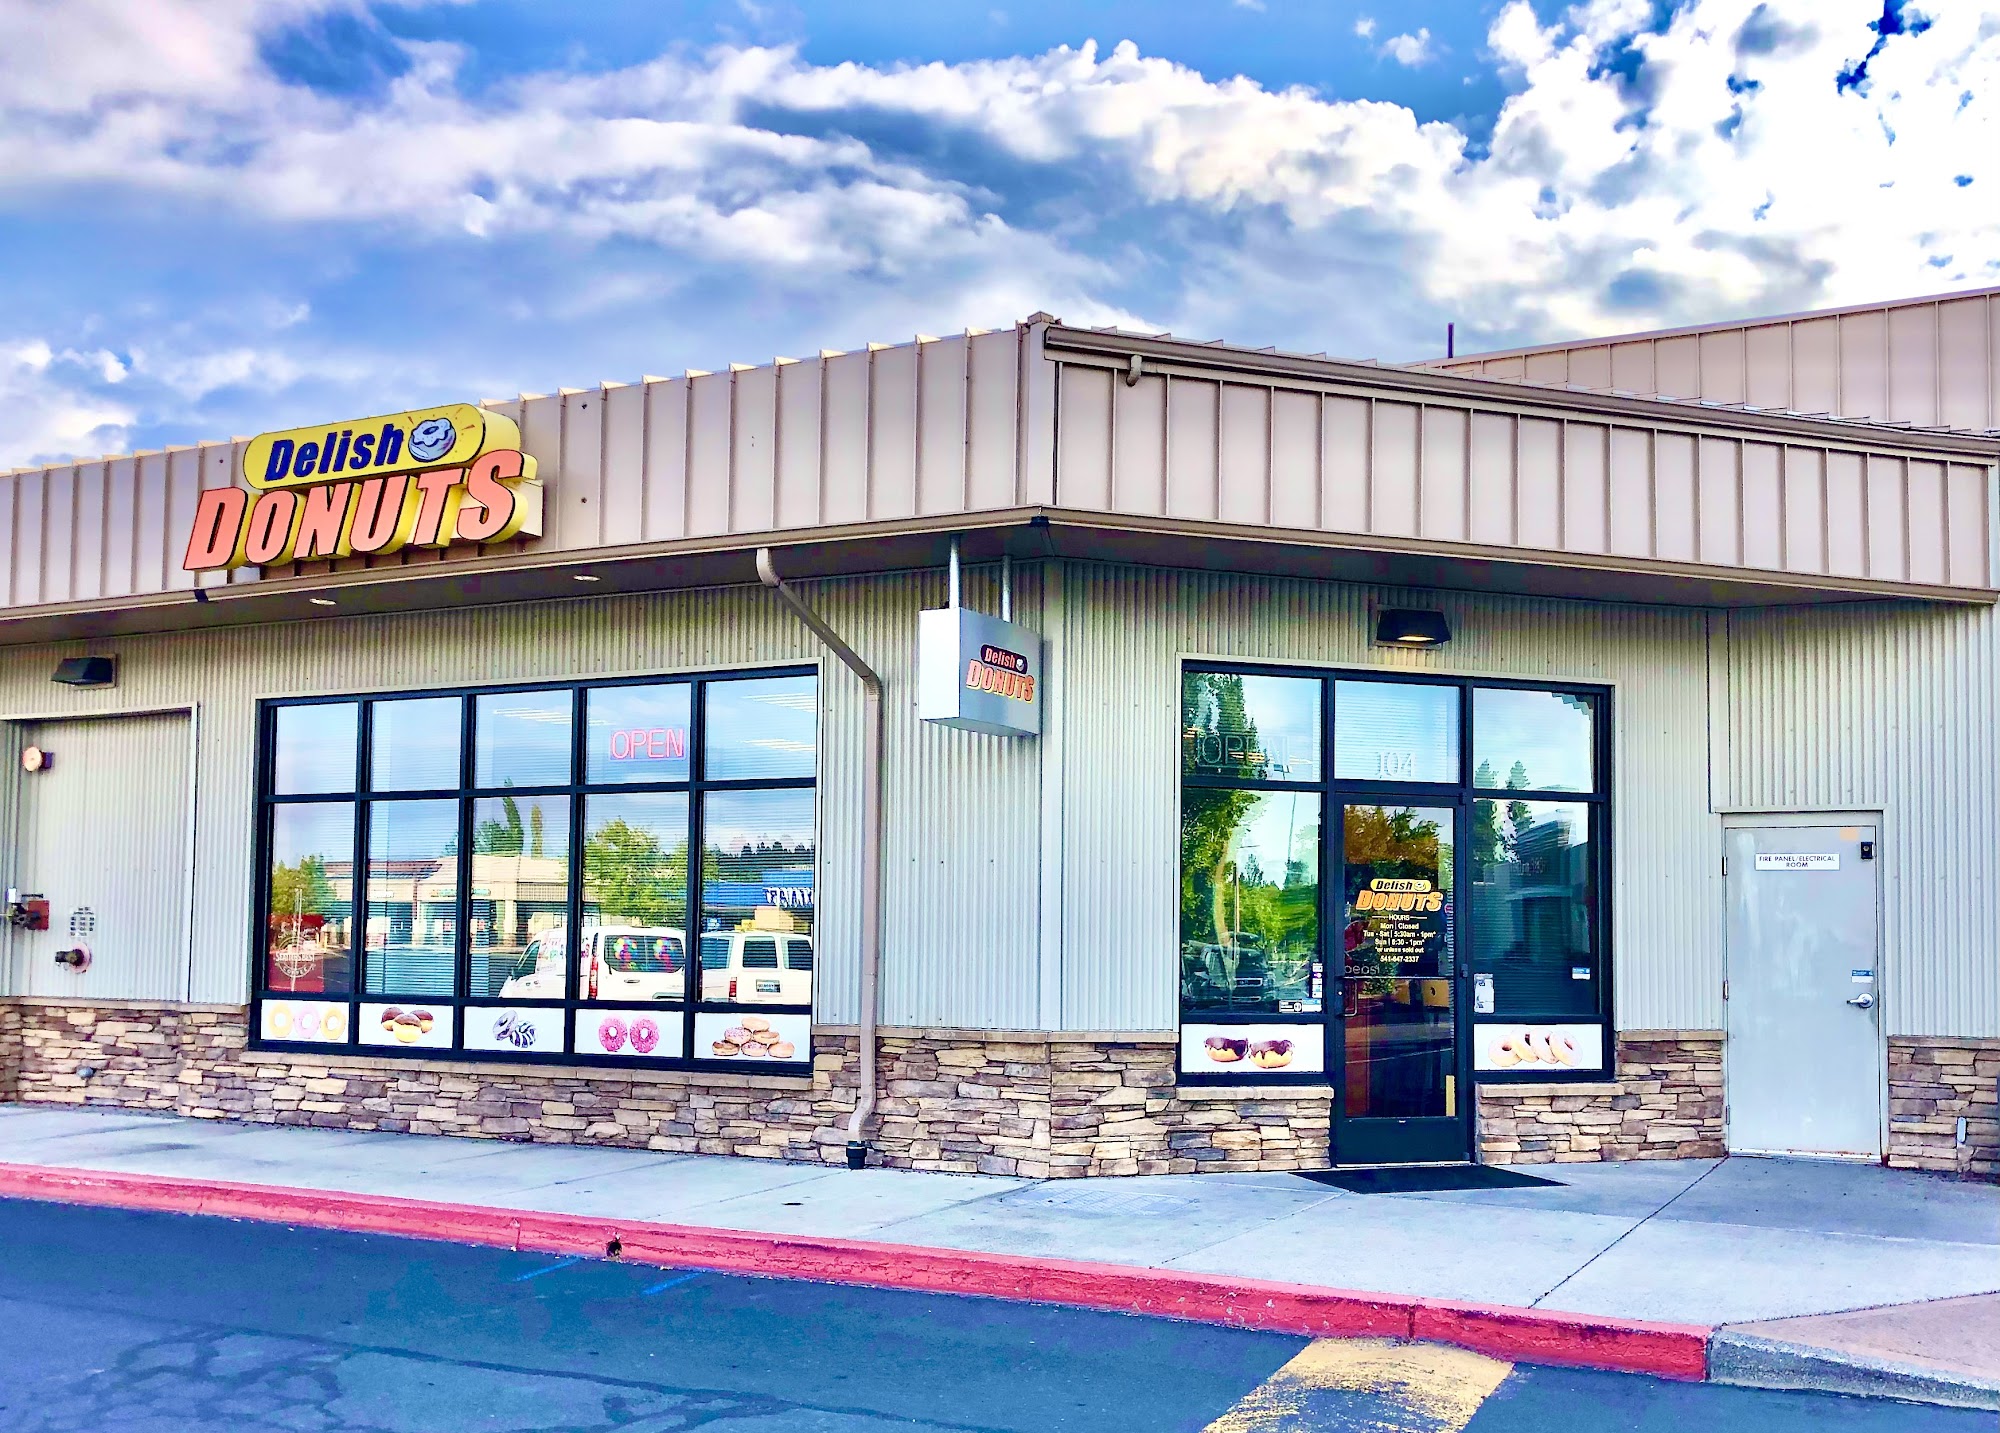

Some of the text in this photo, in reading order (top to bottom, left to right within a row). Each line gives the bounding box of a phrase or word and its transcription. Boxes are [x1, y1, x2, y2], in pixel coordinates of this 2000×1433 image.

[264, 423, 404, 482] Delish
[183, 449, 528, 570] DONUTS
[985, 647, 1016, 669] Delish
[966, 659, 1035, 702] DONUTS
[611, 728, 684, 760] OPEN
[1376, 751, 1416, 777] 104
[1375, 880, 1413, 890] Delish
[1356, 890, 1443, 911] DONUTS
[1380, 922, 1394, 930] Mon
[1397, 922, 1420, 930] Closed
